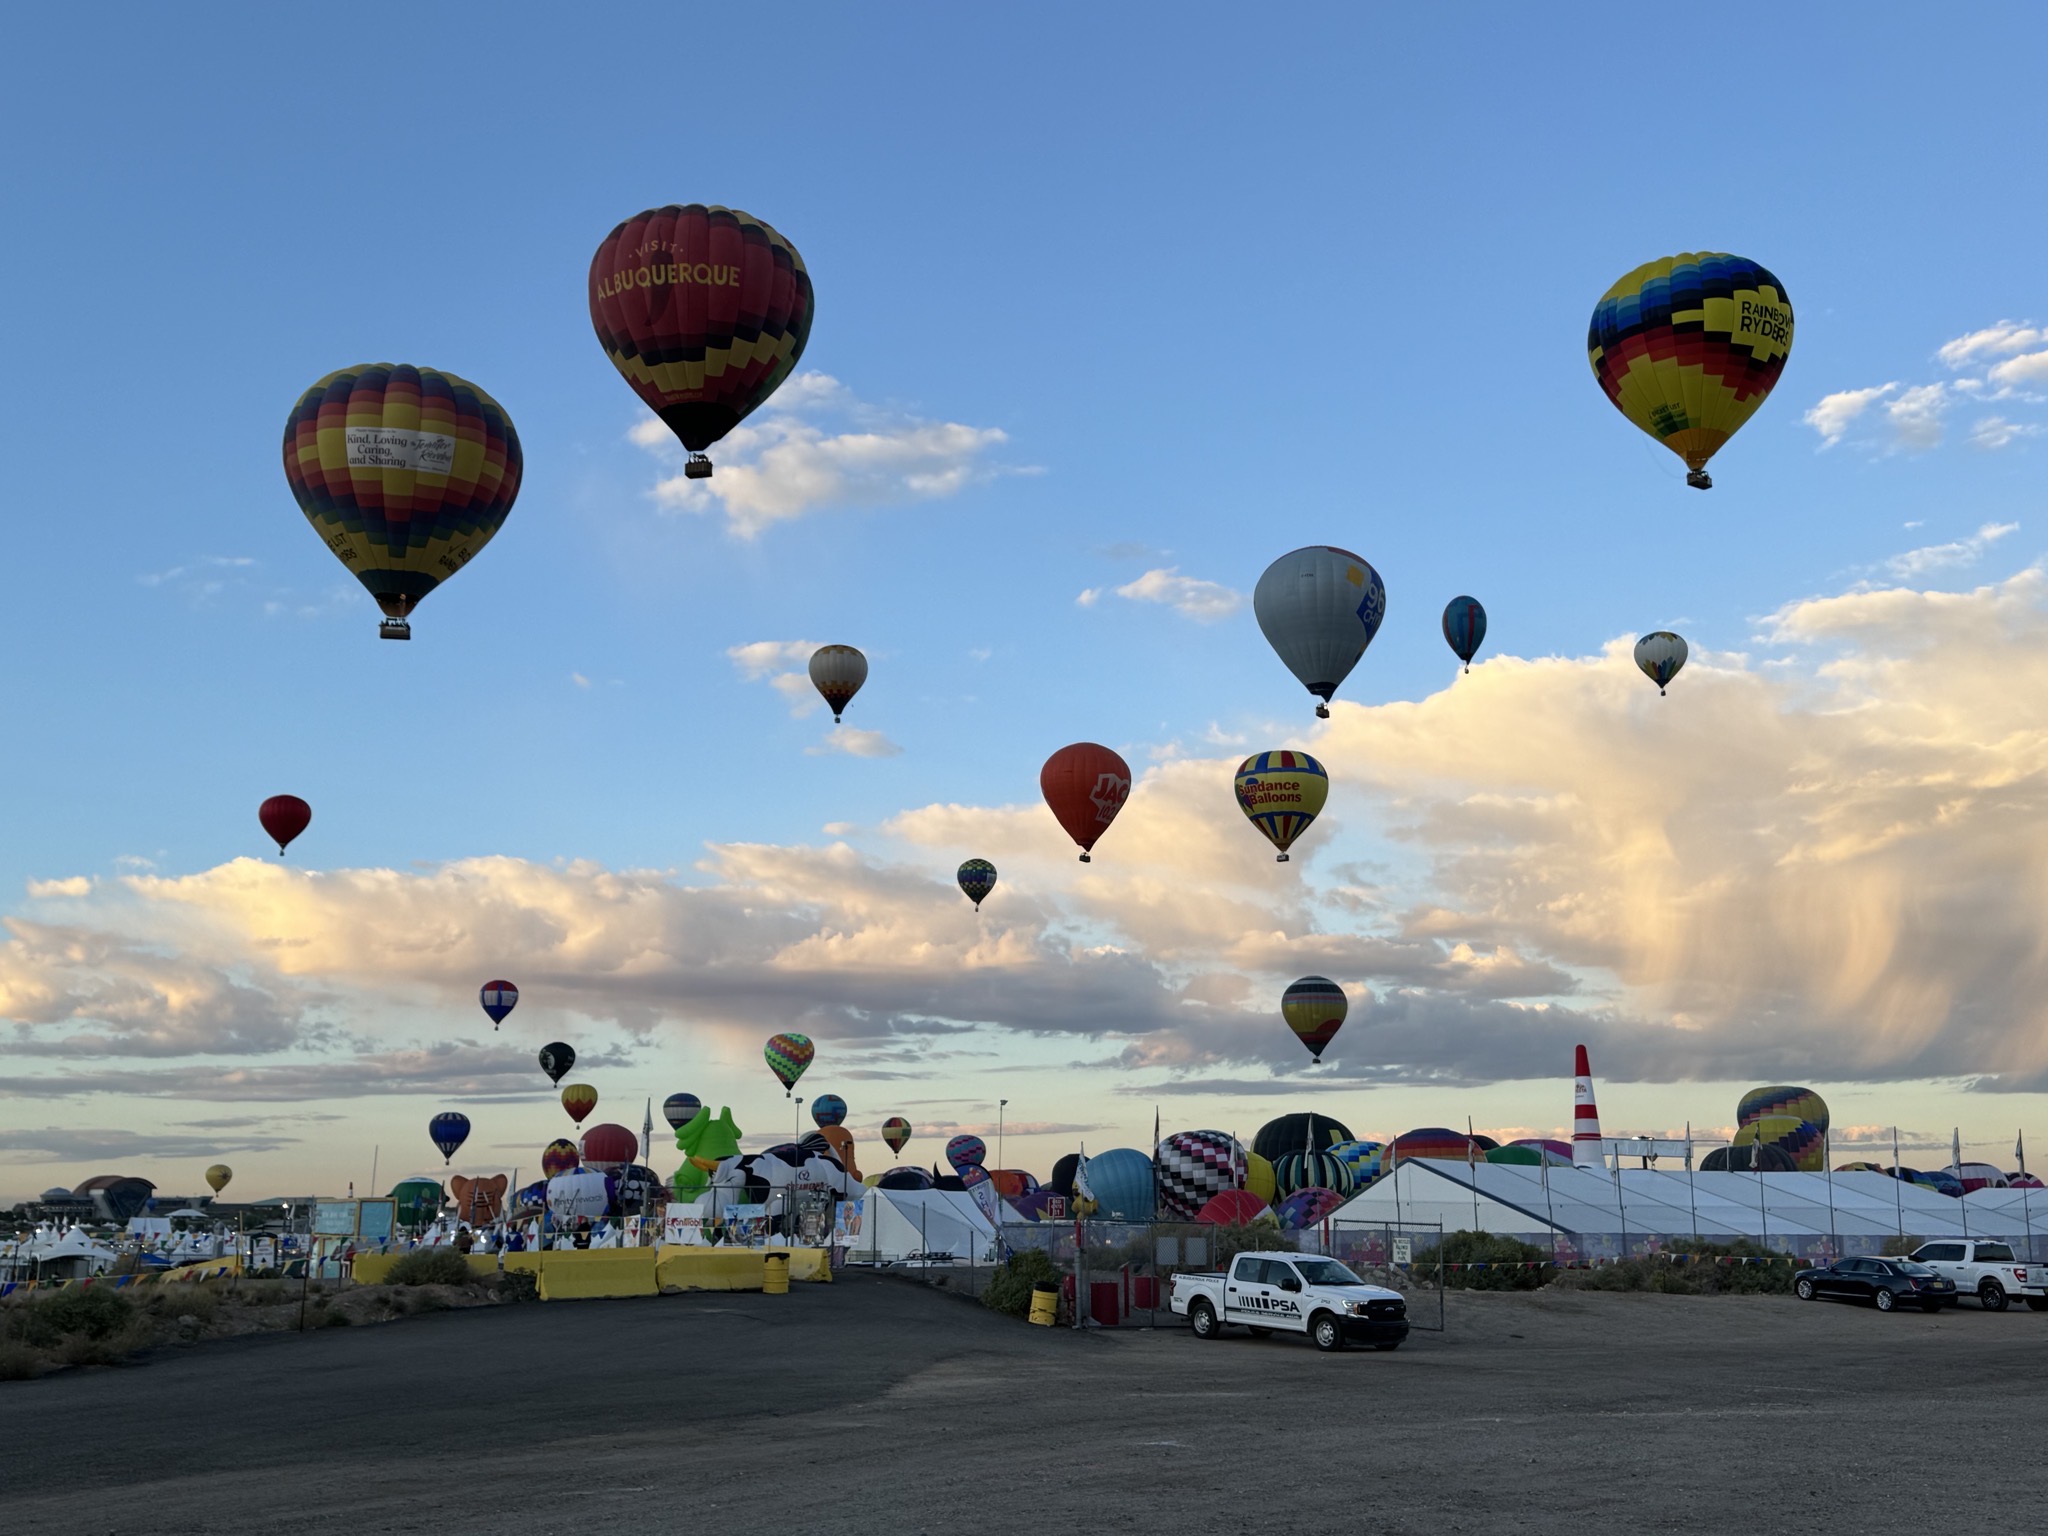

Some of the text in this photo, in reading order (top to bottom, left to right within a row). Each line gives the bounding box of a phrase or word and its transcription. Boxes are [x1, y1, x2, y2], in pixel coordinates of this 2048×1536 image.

[635, 239, 678, 257] VISIT
[597, 263, 742, 302] ALBUQUERQUE
[374, 433, 408, 450] Loving
[349, 454, 367, 465] and
[367, 454, 407, 470] Sharing
[1239, 780, 1300, 796] Sundance
[1250, 792, 1302, 805] Balloons
[1270, 1298, 1301, 1313] PSA
